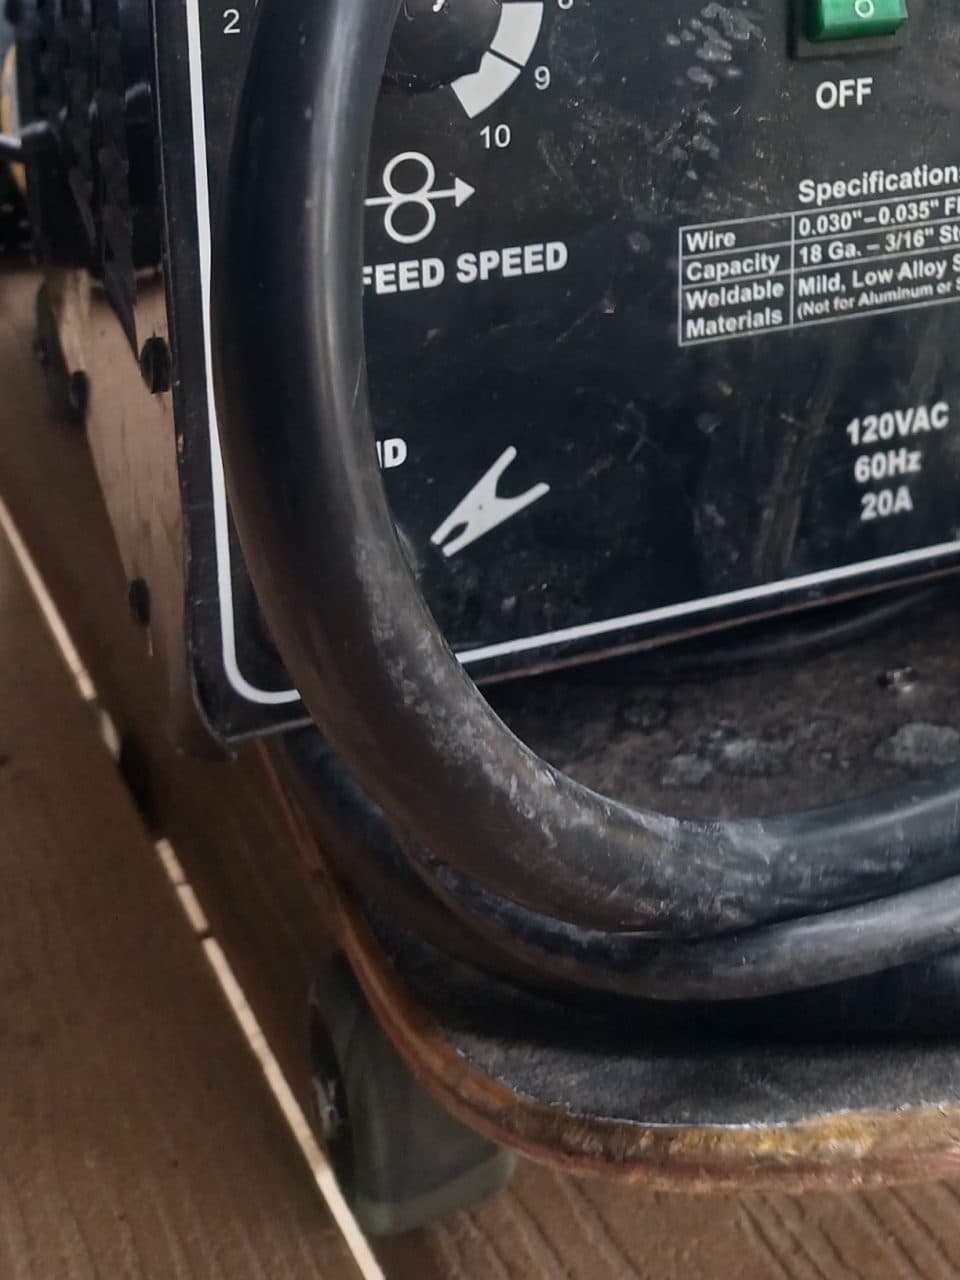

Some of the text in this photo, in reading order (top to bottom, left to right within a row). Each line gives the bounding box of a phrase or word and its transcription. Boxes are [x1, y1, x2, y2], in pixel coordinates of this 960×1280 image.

[223, 9, 241, 34] 2
[534, 66, 551, 90] 9
[816, 77, 873, 110] OFF
[479, 124, 511, 149] 10
[686, 230, 736, 253] Wire
[799, 243, 823, 265] 18
[828, 240, 862, 261] Ga.
[885, 227, 934, 252] 3/16"
[456, 241, 568, 284] SPEED
[686, 252, 780, 282] Capacity
[798, 272, 847, 297] Mild,
[852, 268, 893, 289] Low
[898, 258, 947, 281] Alloy
[685, 279, 785, 312] Weldable
[797, 299, 830, 320] (Not
[833, 295, 855, 311] for
[858, 283, 934, 307] Aluminum
[937, 281, 953, 295] or
[686, 307, 783, 339] Materials
[846, 402, 950, 446] 120VAC
[854, 447, 922, 483] 60Hz
[861, 485, 914, 520] 20A
